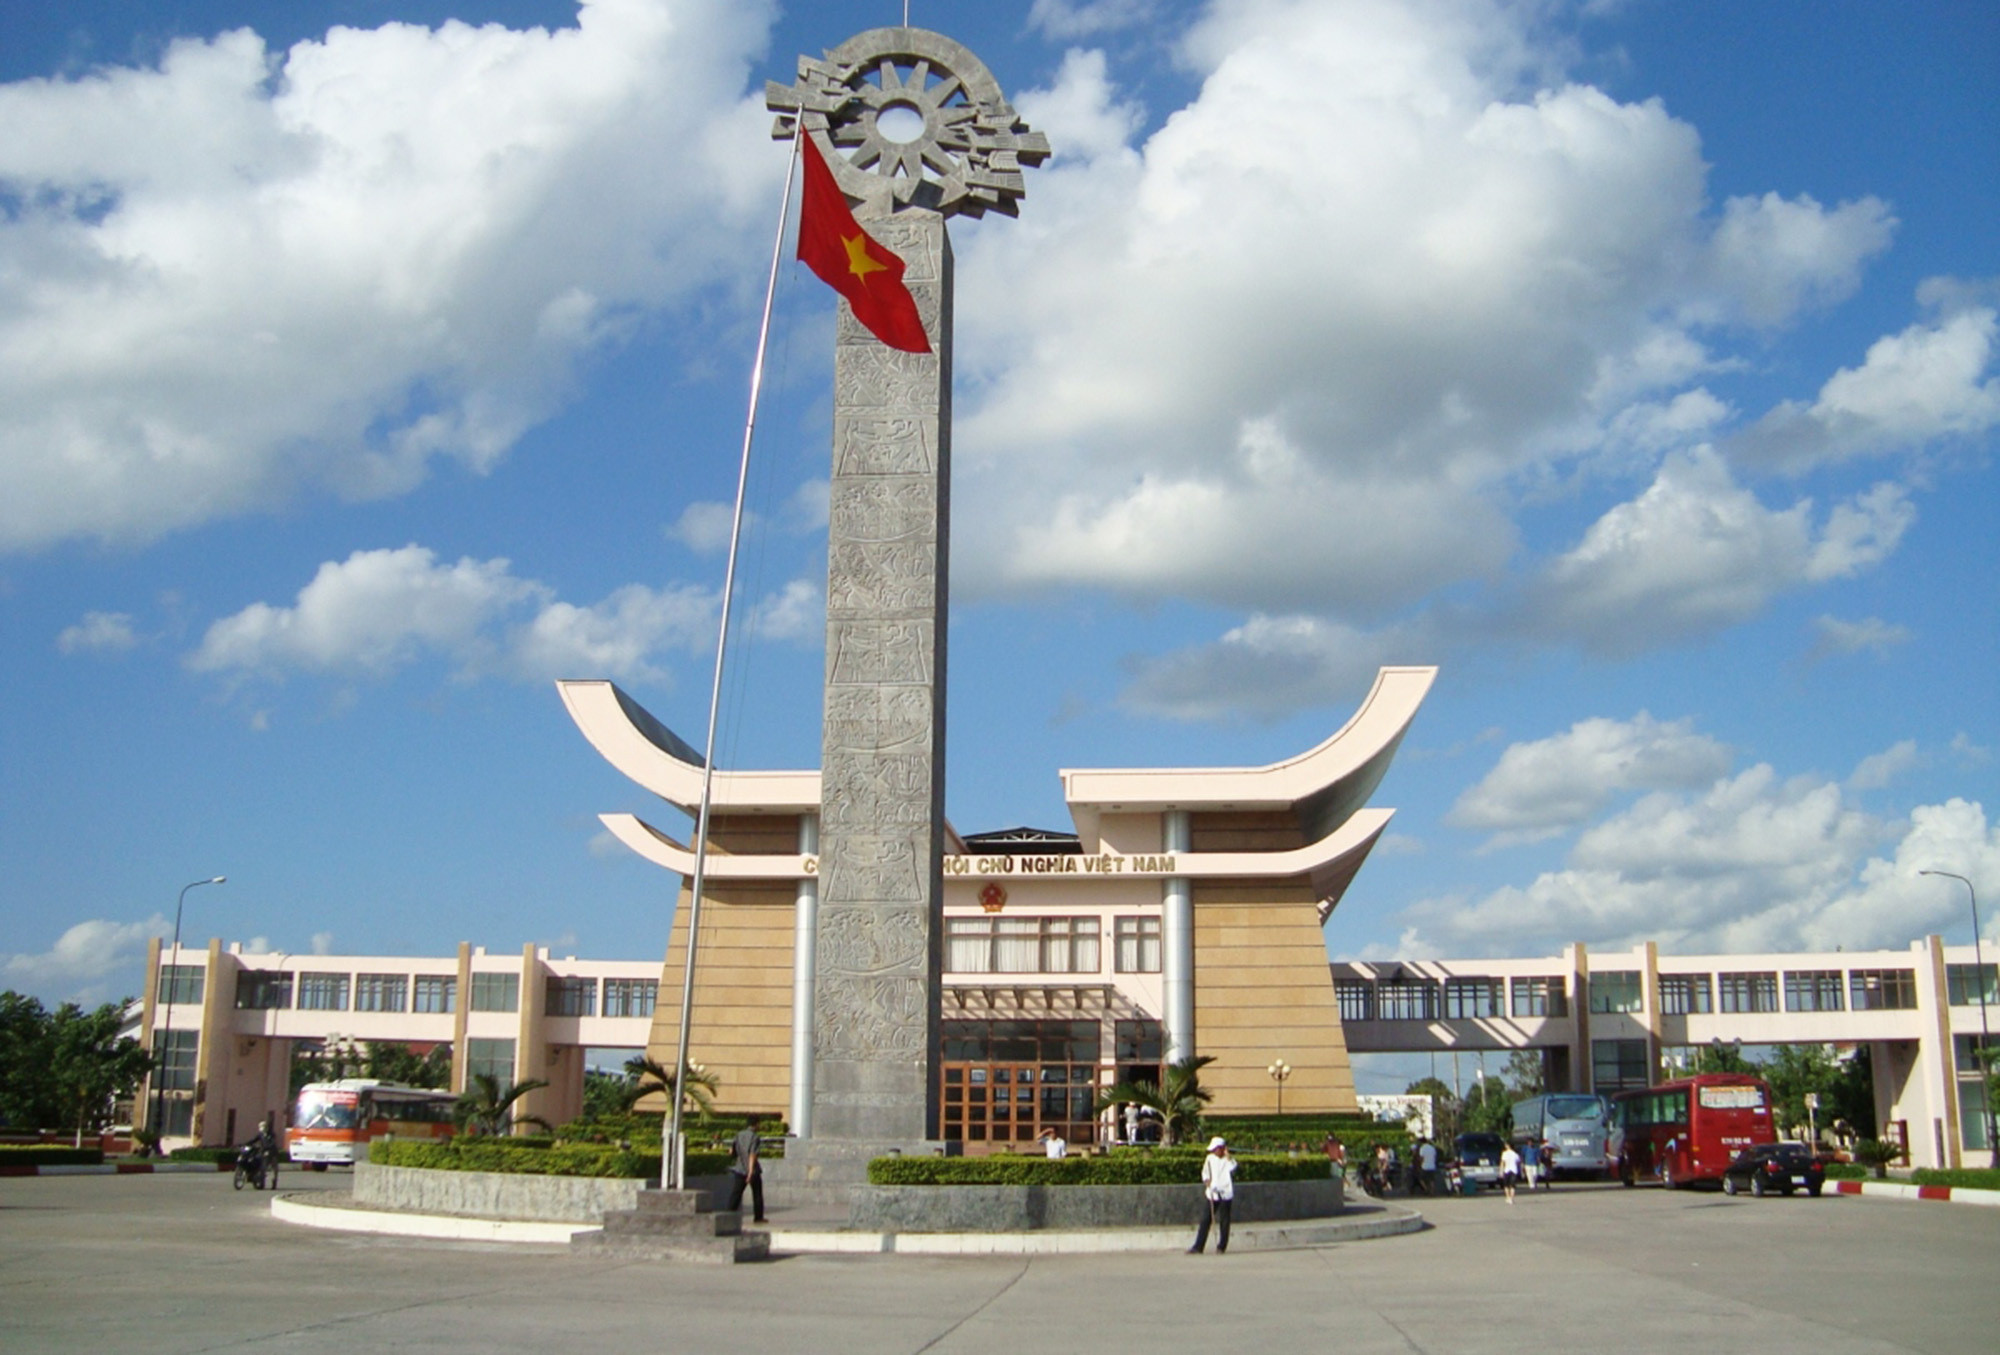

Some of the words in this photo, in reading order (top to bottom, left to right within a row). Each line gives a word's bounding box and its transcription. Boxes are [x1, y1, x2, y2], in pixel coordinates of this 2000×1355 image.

[977, 854, 1014, 874] CHỦ
[1021, 853, 1077, 873] NGHĨA
[1083, 853, 1125, 875] VIỆT
[1132, 856, 1176, 873] NAM
